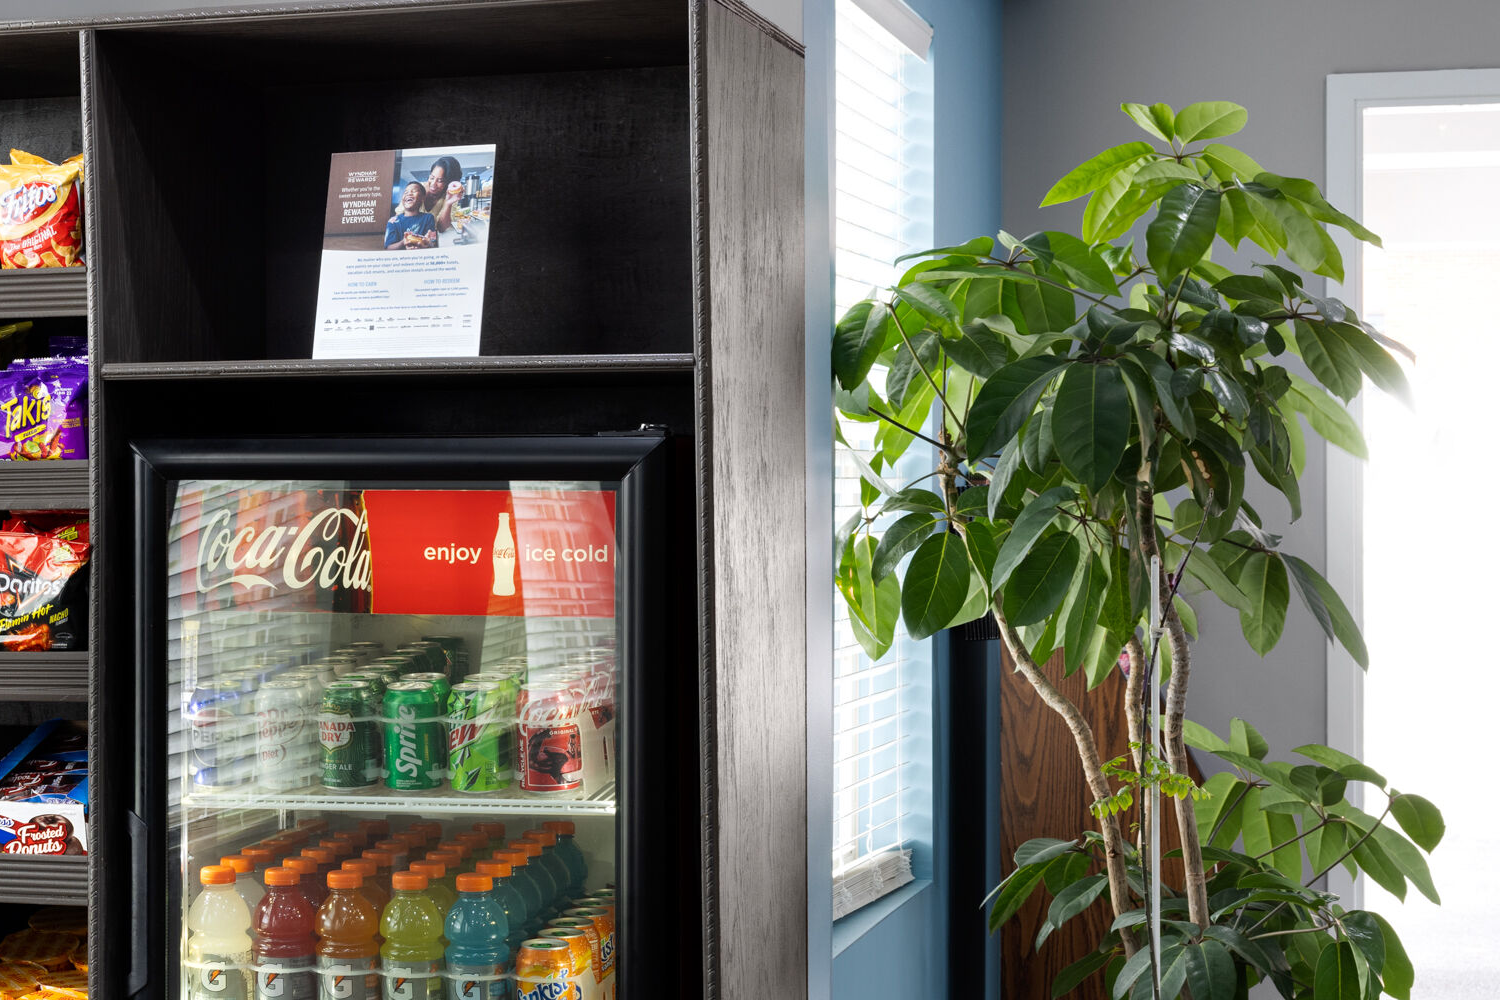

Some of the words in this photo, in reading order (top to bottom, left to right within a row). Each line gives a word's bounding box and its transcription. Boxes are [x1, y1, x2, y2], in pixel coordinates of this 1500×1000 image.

[0, 183, 57, 225] Fritos
[342, 200, 377, 208] WYNDHAM
[343, 208, 374, 216] REWARDS
[342, 216, 376, 224] EVERYONE.
[22, 225, 57, 249] ORIGINAL
[1, 394, 52, 438] Takis
[197, 507, 373, 594] Coca-Cola
[424, 544, 483, 565] enjoy
[525, 544, 556, 562] ice
[562, 543, 608, 562] cold
[32, 604, 54, 620] Hot
[49, 608, 69, 625] NACHO
[322, 732, 342, 742] DRY
[396, 704, 422, 778] Sprite
[549, 728, 575, 736] ORIGINAL
[262, 750, 279, 761] Diet
[17, 824, 64, 844] Frosted
[6, 839, 63, 855] Donuts
[200, 960, 228, 992] G
[258, 962, 284, 998] G
[324, 964, 353, 1000] G
